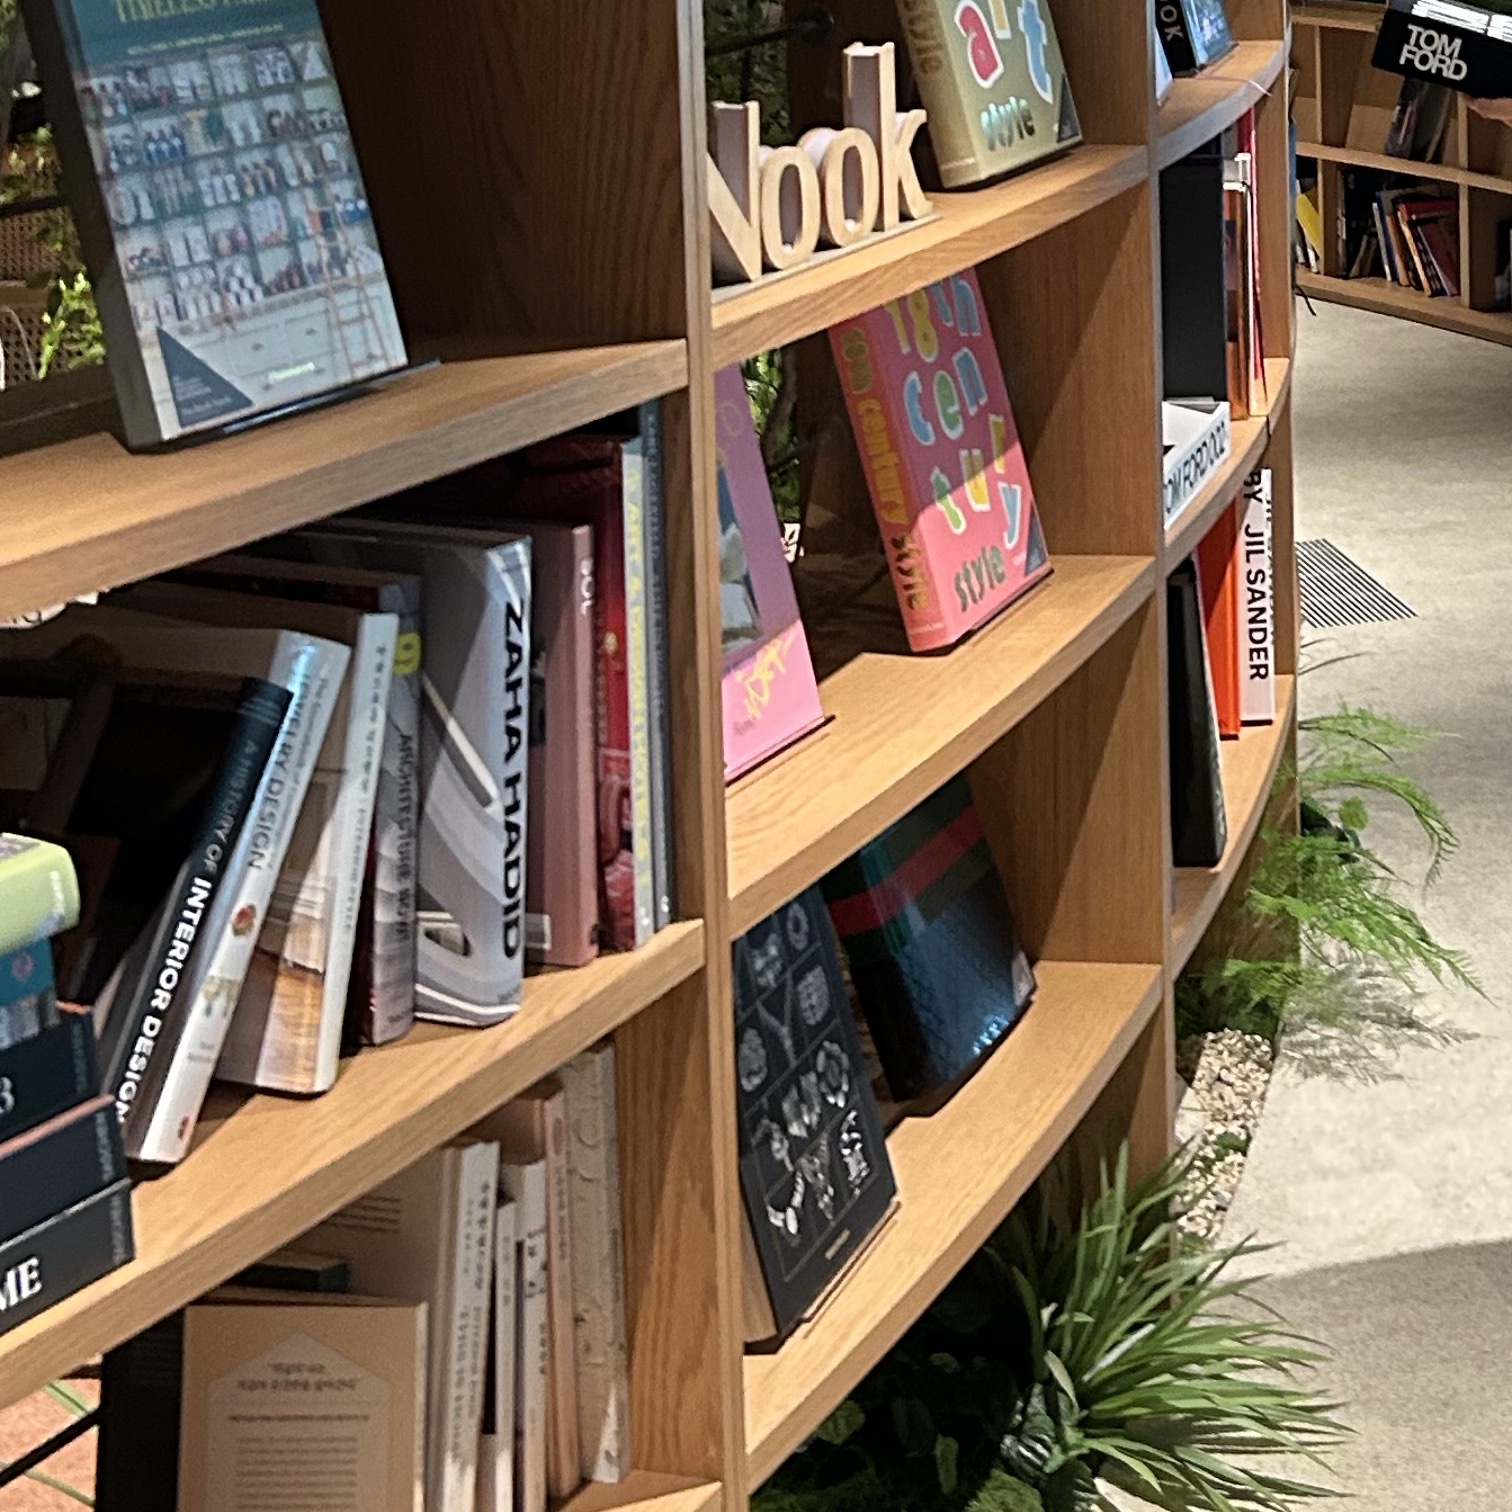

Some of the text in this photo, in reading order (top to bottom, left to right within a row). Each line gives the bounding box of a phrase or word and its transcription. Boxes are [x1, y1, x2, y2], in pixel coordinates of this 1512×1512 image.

[1400, 43, 1467, 82] FORD
[1407, 24, 1462, 59] TOM
[857, 398, 910, 526] century
[954, 544, 1006, 613] style
[1244, 524, 1262, 564] JIL
[1245, 564, 1270, 681] SANDER
[248, 672, 311, 870] JEWELRY DESIGN
[502, 599, 524, 960] ZAHA HADID
[203, 844, 224, 875] OF
[151, 877, 212, 1011] INTERIOR
[115, 1015, 162, 1125] DESIGN
